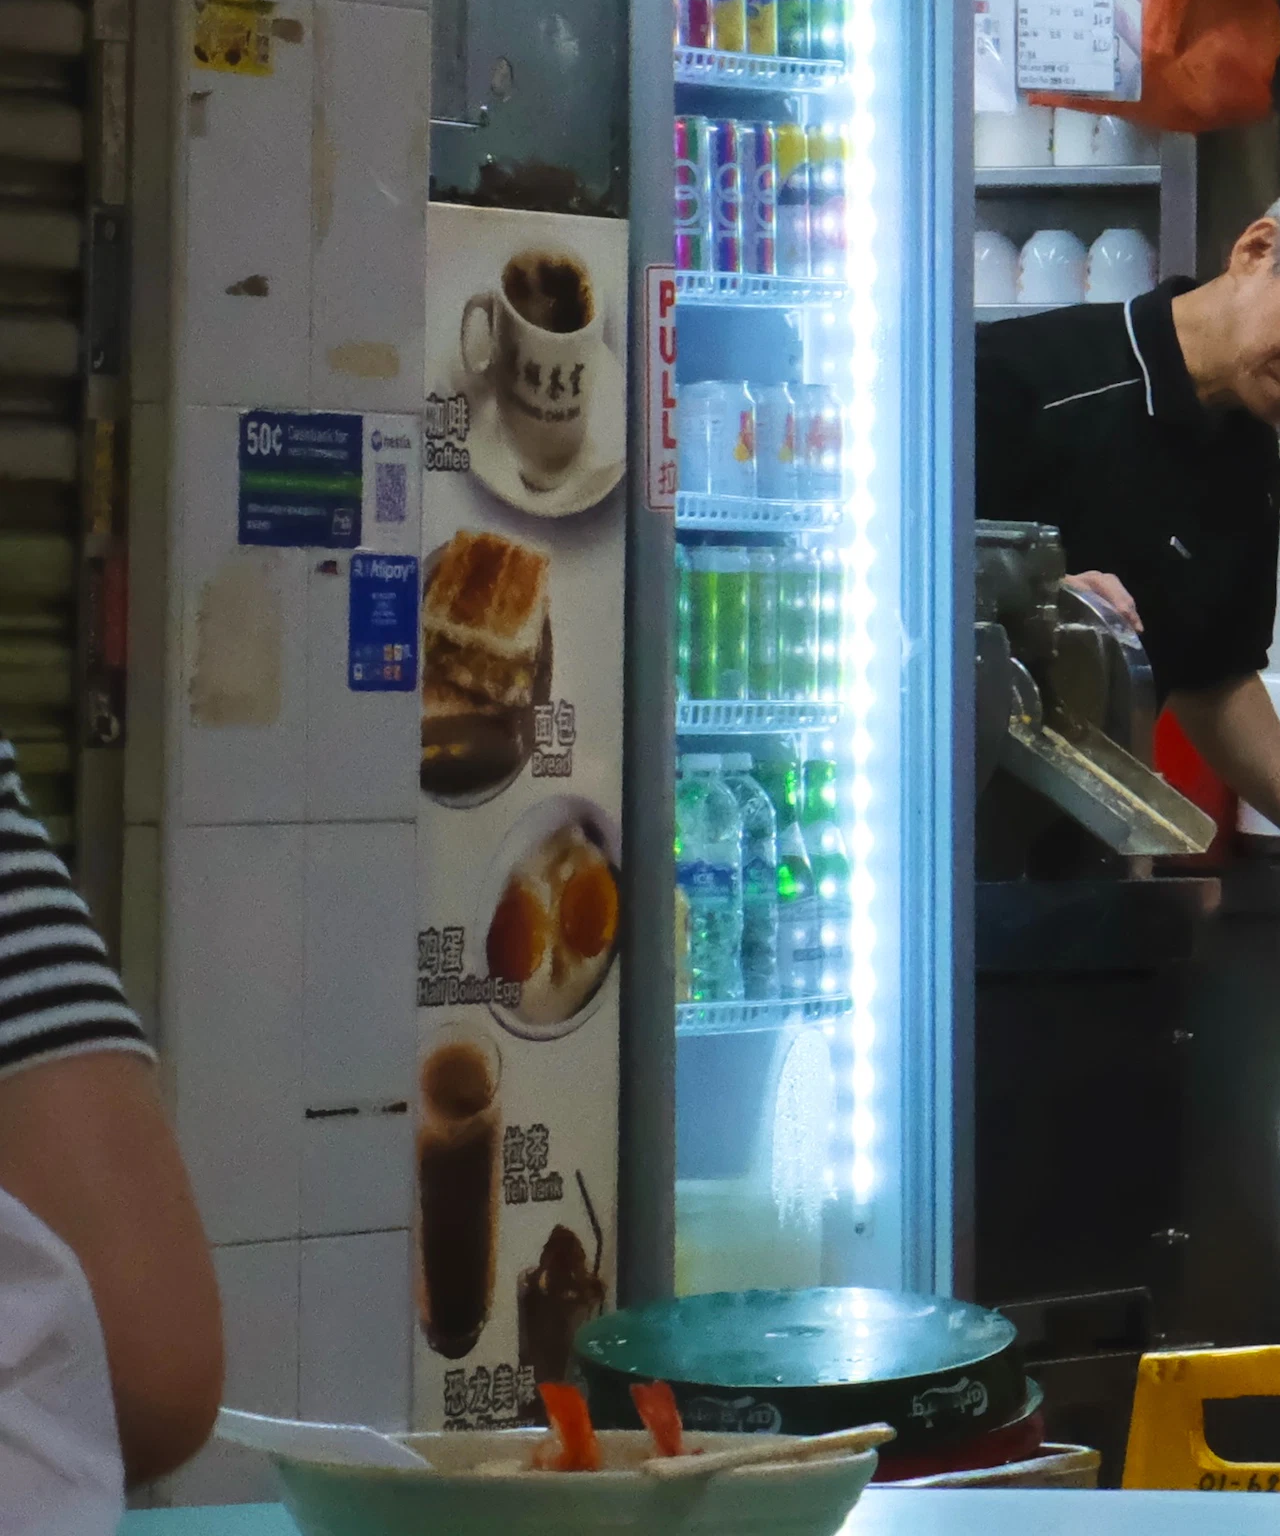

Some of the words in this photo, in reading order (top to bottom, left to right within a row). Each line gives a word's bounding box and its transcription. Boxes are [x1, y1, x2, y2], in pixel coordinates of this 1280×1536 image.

[247, 421, 283, 457] 50¢
[426, 442, 470, 472] Coffee
[531, 749, 573, 778] Bread
[493, 975, 522, 1009] Egg
